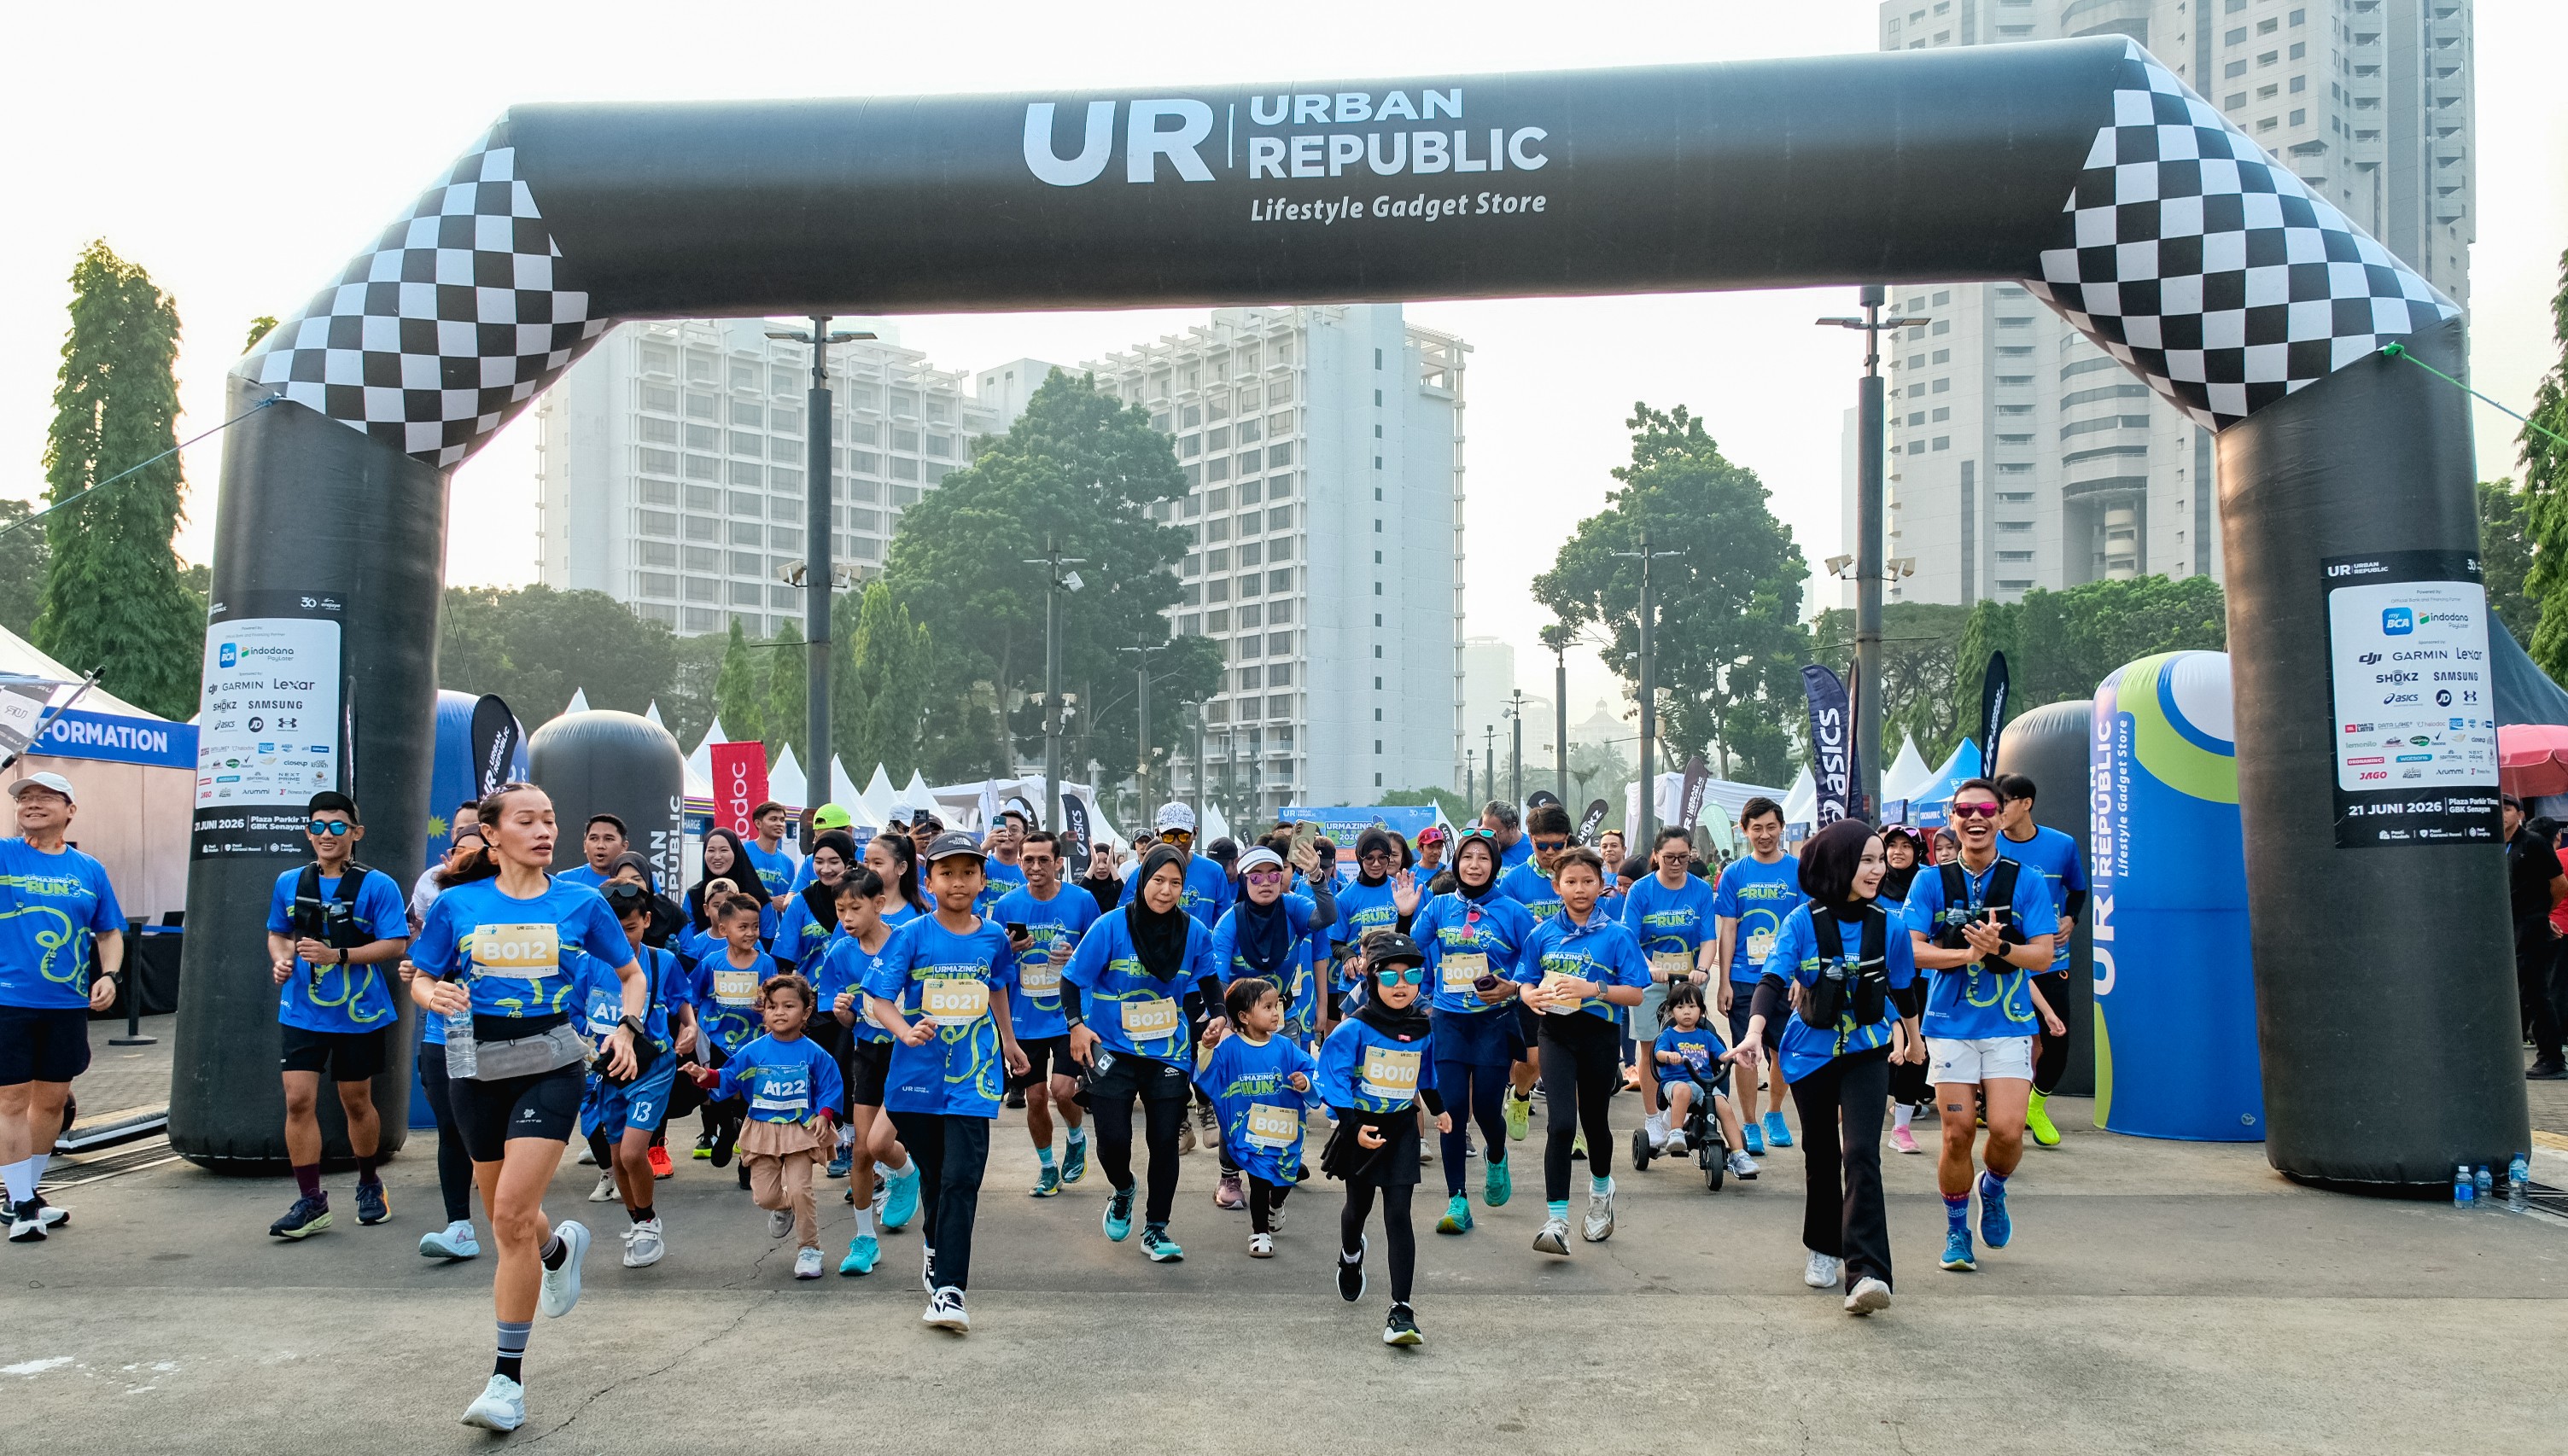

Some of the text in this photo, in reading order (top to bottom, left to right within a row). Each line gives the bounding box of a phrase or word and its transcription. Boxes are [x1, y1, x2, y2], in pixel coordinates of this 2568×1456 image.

[1249, 89, 1462, 125] URBAN
[1024, 99, 1216, 187] UR
[1248, 127, 1550, 179] REPUBLIC
[1251, 191, 1546, 225] Lifestyle Gadget Store
[2327, 564, 2350, 577] UR
[301, 597, 317, 608] 30
[2386, 618, 2410, 628] BCA
[2431, 613, 2469, 621] indodana
[250, 647, 295, 655] indodana
[2393, 650, 2448, 661] GARMIN
[2456, 648, 2482, 661] Lexar
[222, 681, 264, 691] GARMIN
[273, 678, 315, 690] Lexar
[2376, 672, 2478, 684] SHOKZ SAMSUNG
[2437, 693, 2449, 702] JD
[213, 701, 303, 712] SHOKZ SAMSUNG
[250, 720, 262, 729] JD
[37, 717, 168, 753] FORMATION
[489, 731, 502, 766] URBAN
[493, 725, 510, 774] REPUBLIC
[1984, 735, 1994, 778] UR
[2360, 772, 2388, 780] JAGO
[730, 761, 750, 842] odoc
[2097, 719, 2112, 877] REPUBLIC
[2116, 719, 2130, 877] Lifestyle Gadget Store
[2349, 801, 2443, 816] 21 JUNI 2026
[201, 819, 217, 830] JUNI
[219, 818, 245, 830] 2026
[1579, 809, 1602, 845] HOKZ
[1326, 830, 1359, 847] RU
[668, 795, 681, 905] EPUBLIC
[651, 831, 667, 889] BAN
[26, 881, 69, 895] RUN
[1748, 888, 1777, 899] RUN
[1362, 911, 1390, 924] RUN
[1533, 905, 1561, 917] RUN
[1657, 915, 1685, 927] RUN
[2092, 894, 2116, 996] UR
[934, 964, 978, 973] URMAZING
[1129, 963, 1153, 976] RU
[762, 1080, 806, 1097] A122
[632, 1101, 652, 1122] 13
